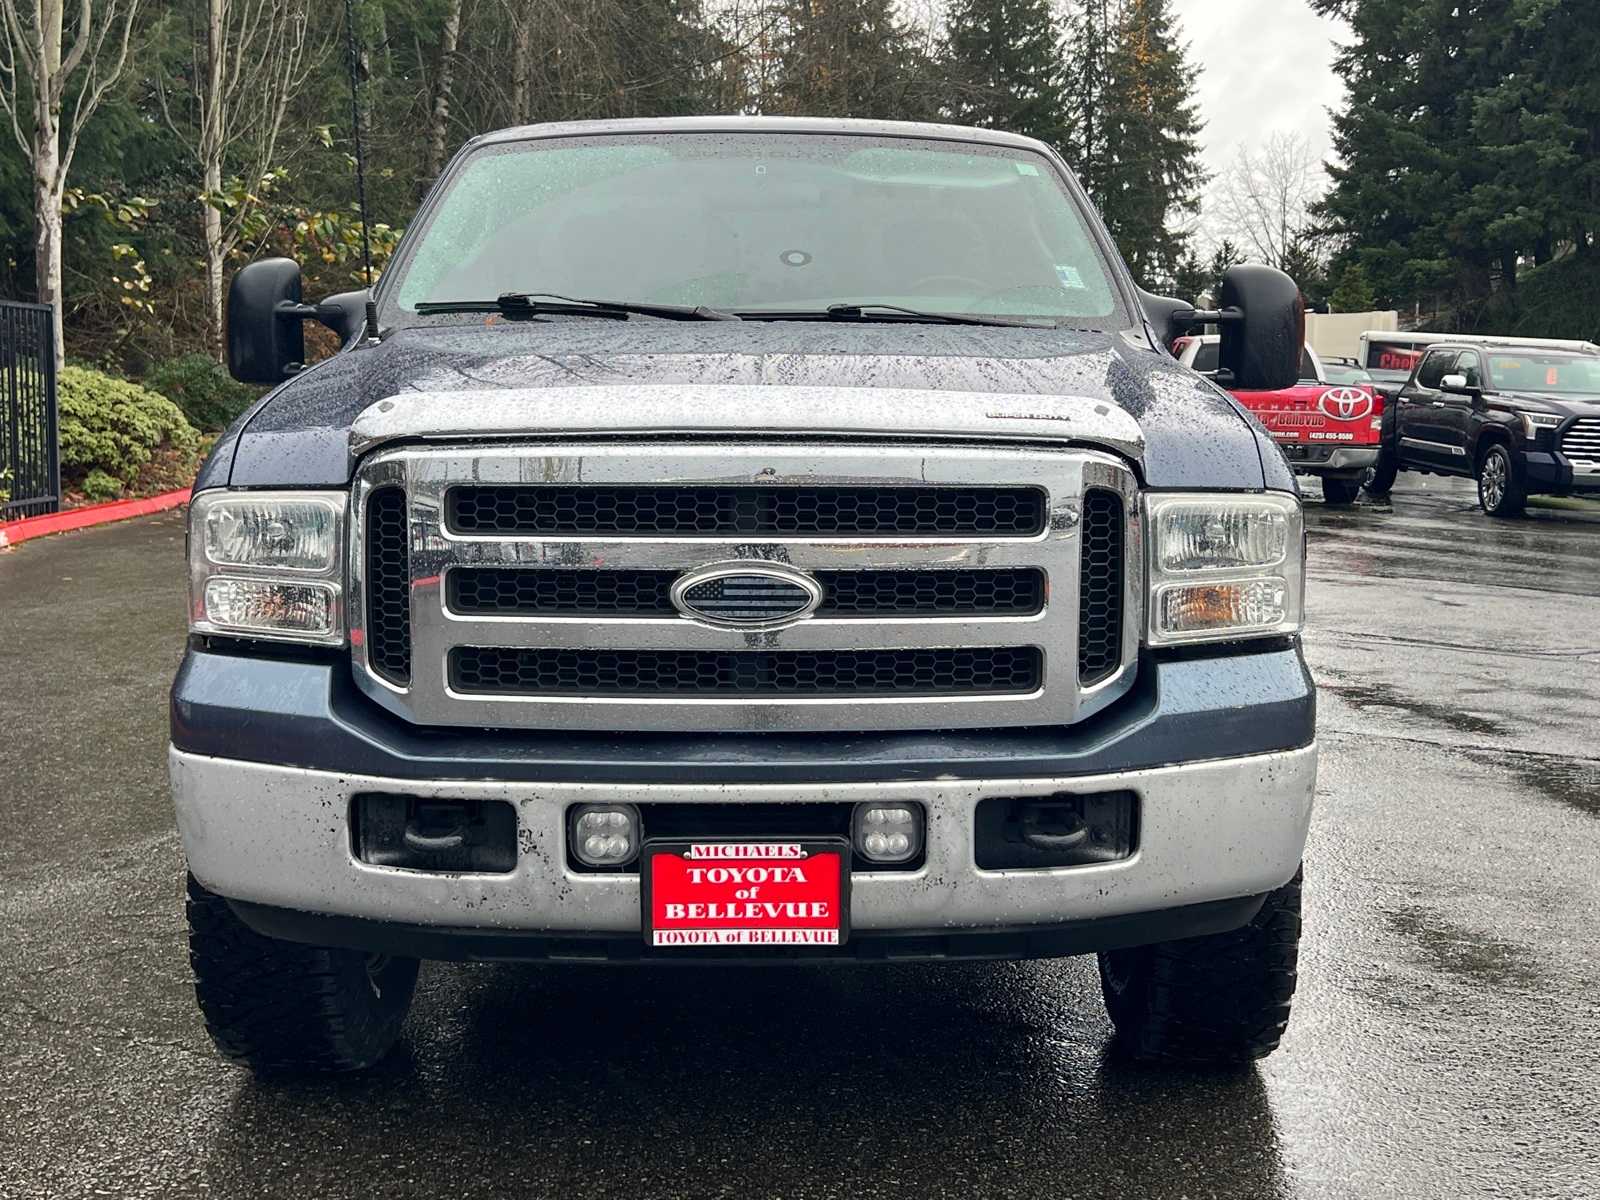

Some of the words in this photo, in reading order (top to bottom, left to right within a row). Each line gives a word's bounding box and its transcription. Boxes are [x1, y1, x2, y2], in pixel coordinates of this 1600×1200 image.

[694, 845, 799, 857] MICHAELS
[687, 867, 807, 884] TOYOTA
[735, 886, 760, 899] of
[664, 902, 829, 919] BELLEVUE
[655, 931, 721, 944] TOYOTA
[726, 930, 744, 943] of
[749, 930, 837, 944] BELLEVUE
